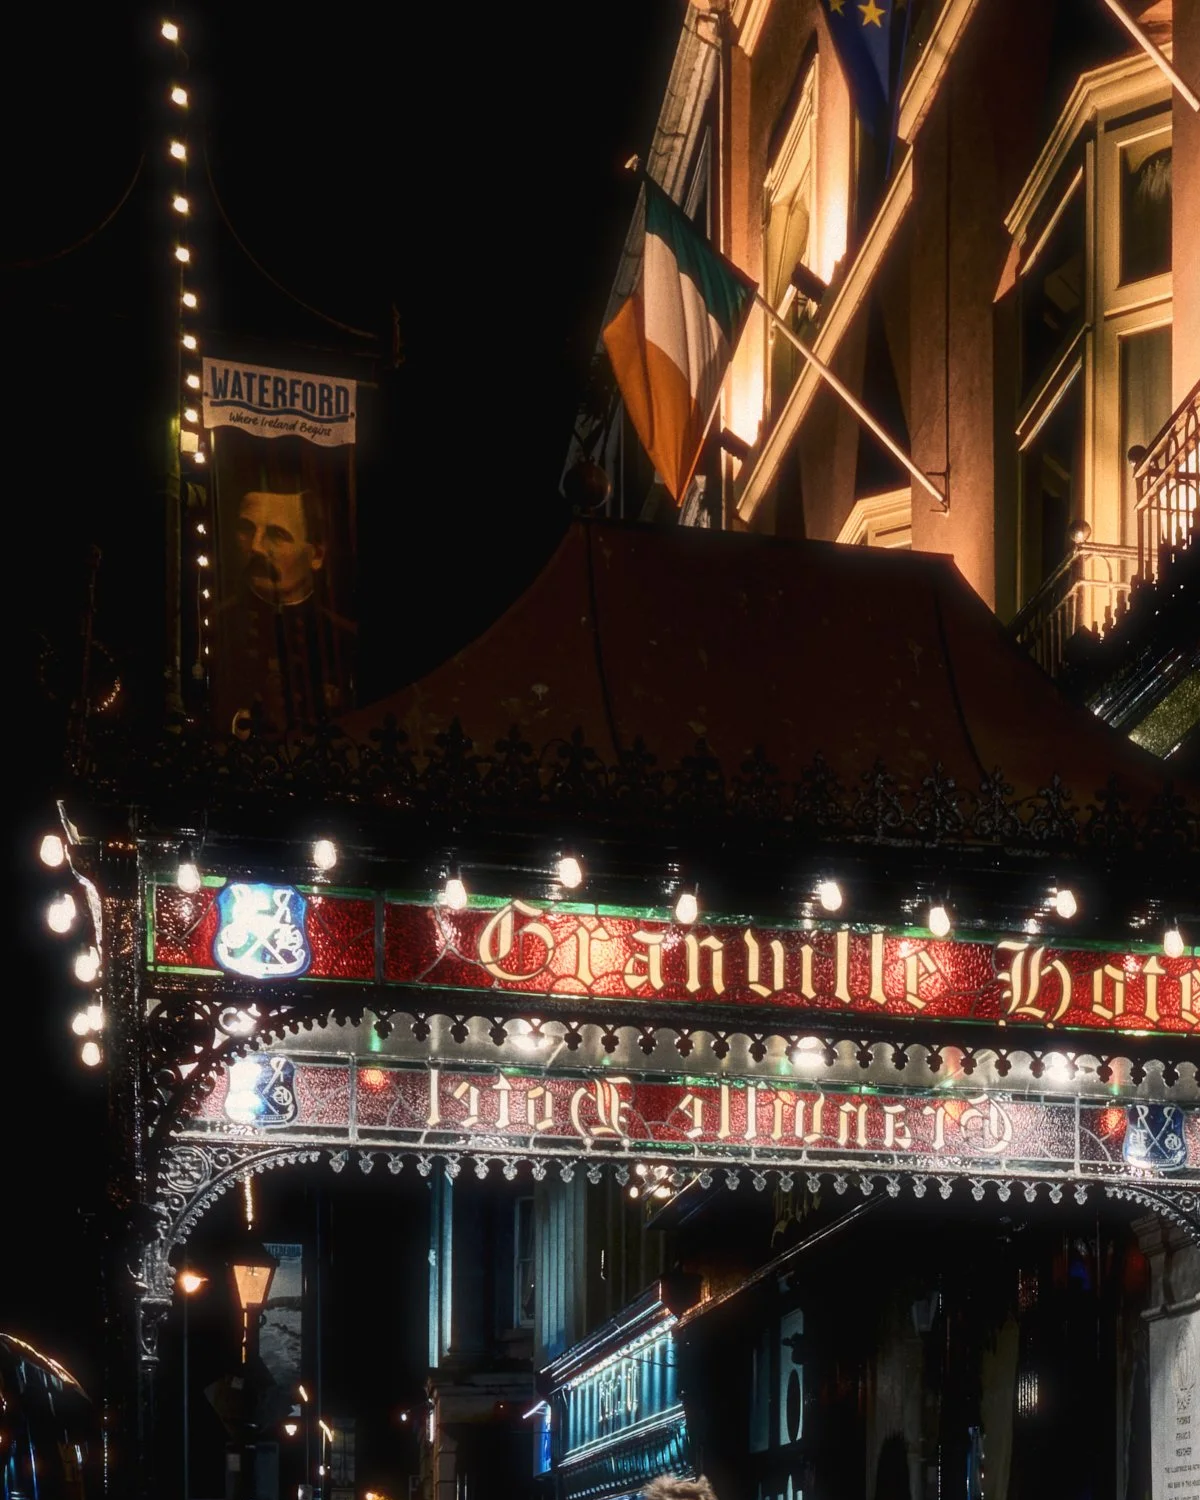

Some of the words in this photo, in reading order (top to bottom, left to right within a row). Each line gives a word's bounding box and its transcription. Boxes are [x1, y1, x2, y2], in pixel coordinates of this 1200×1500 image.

[211, 366, 350, 417] WATERFORD
[229, 411, 259, 426] Where
[261, 417, 298, 431] Ireland
[299, 422, 333, 439] Begins
[478, 899, 946, 1010] Granville
